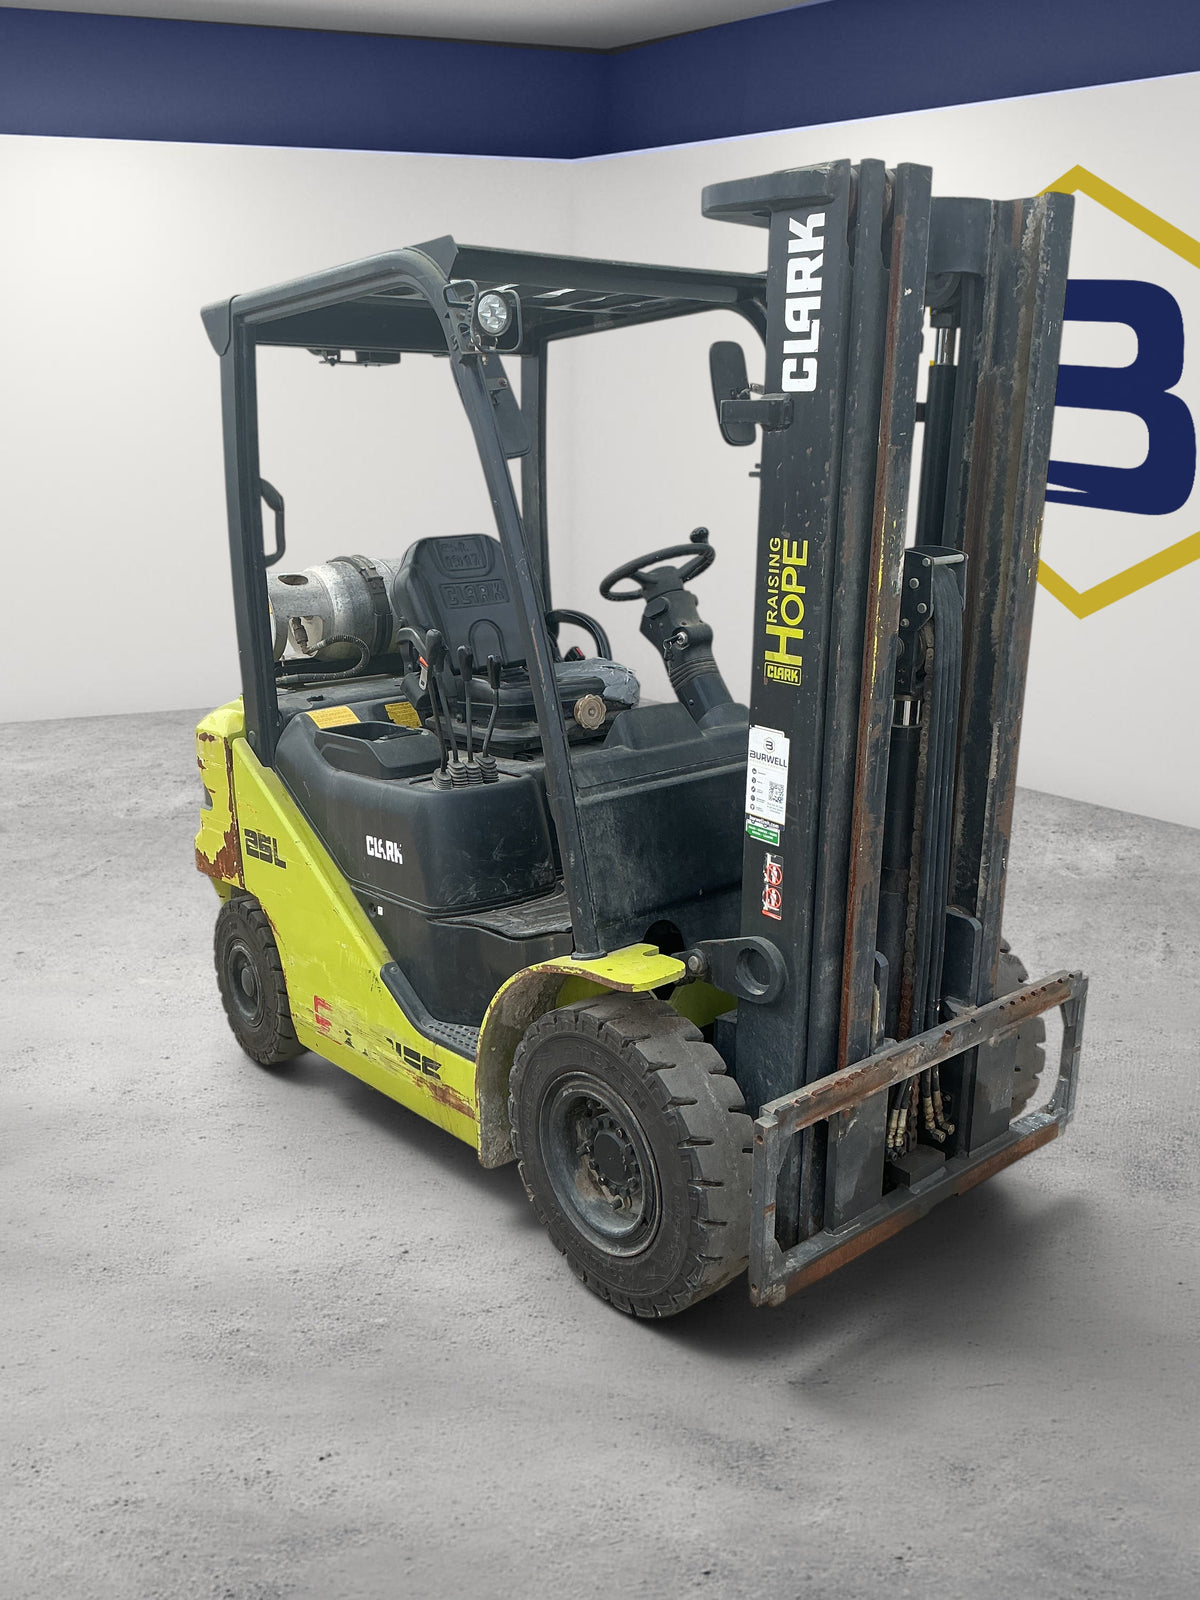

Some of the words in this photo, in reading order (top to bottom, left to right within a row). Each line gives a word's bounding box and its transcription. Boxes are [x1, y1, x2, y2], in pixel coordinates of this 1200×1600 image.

[781, 212, 826, 393] CLARK
[1044, 278, 1197, 516] B
[443, 582, 505, 606] CLARK
[766, 537, 781, 624] RAISING
[764, 538, 809, 667] HOPE
[766, 664, 799, 684] CLARK
[749, 750, 788, 768] BURWELL
[243, 828, 287, 870] 25L
[365, 834, 403, 865] CLARK
